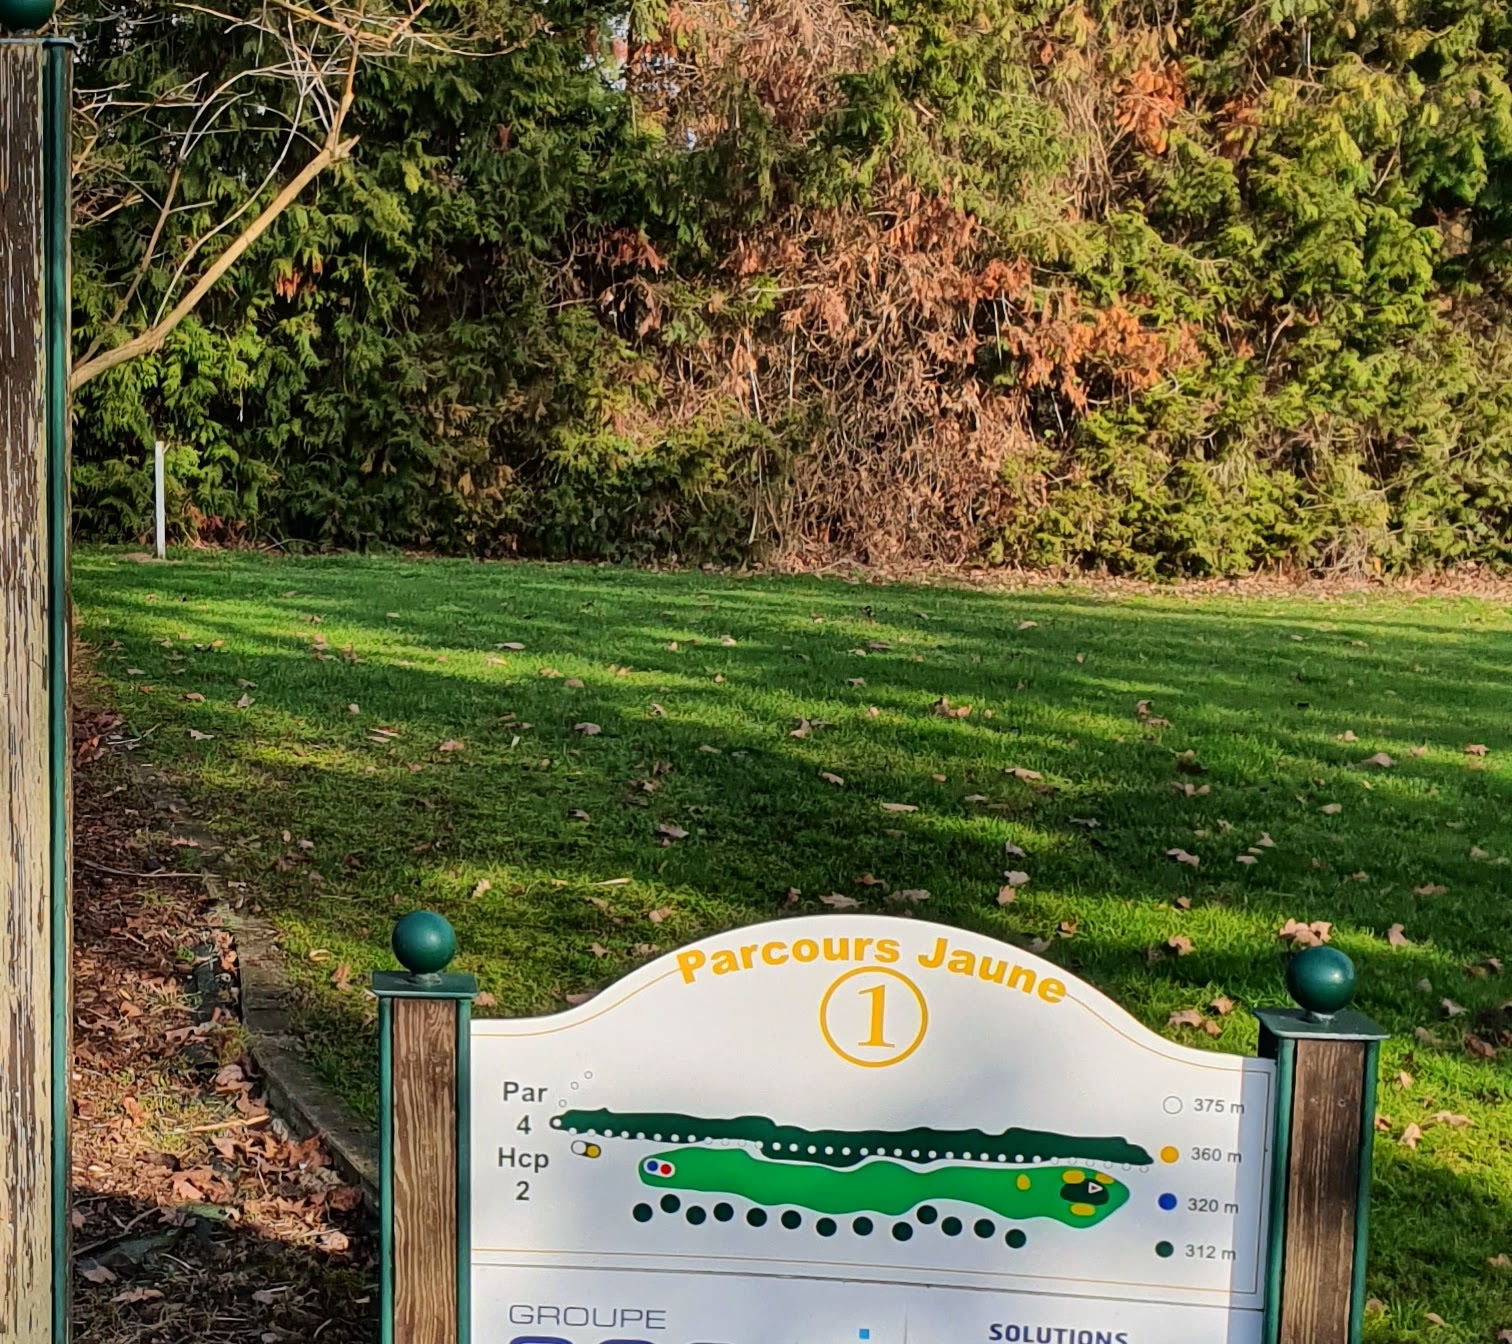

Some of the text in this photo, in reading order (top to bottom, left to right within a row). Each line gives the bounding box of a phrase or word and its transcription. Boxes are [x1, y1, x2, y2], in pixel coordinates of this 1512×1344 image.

[677, 938, 1066, 1003] Parcours Jaune
[858, 984, 895, 1048] 1
[503, 1081, 548, 1102] Par
[1194, 1099, 1244, 1114] 375 m
[517, 1115, 531, 1135] 4
[499, 1147, 549, 1173] Hcp
[1191, 1147, 1241, 1163] 360 m
[516, 1181, 529, 1200] 2
[1188, 1198, 1238, 1214] 320 m
[1185, 1244, 1236, 1260] 312 m
[509, 1305, 666, 1329] GROUPE
